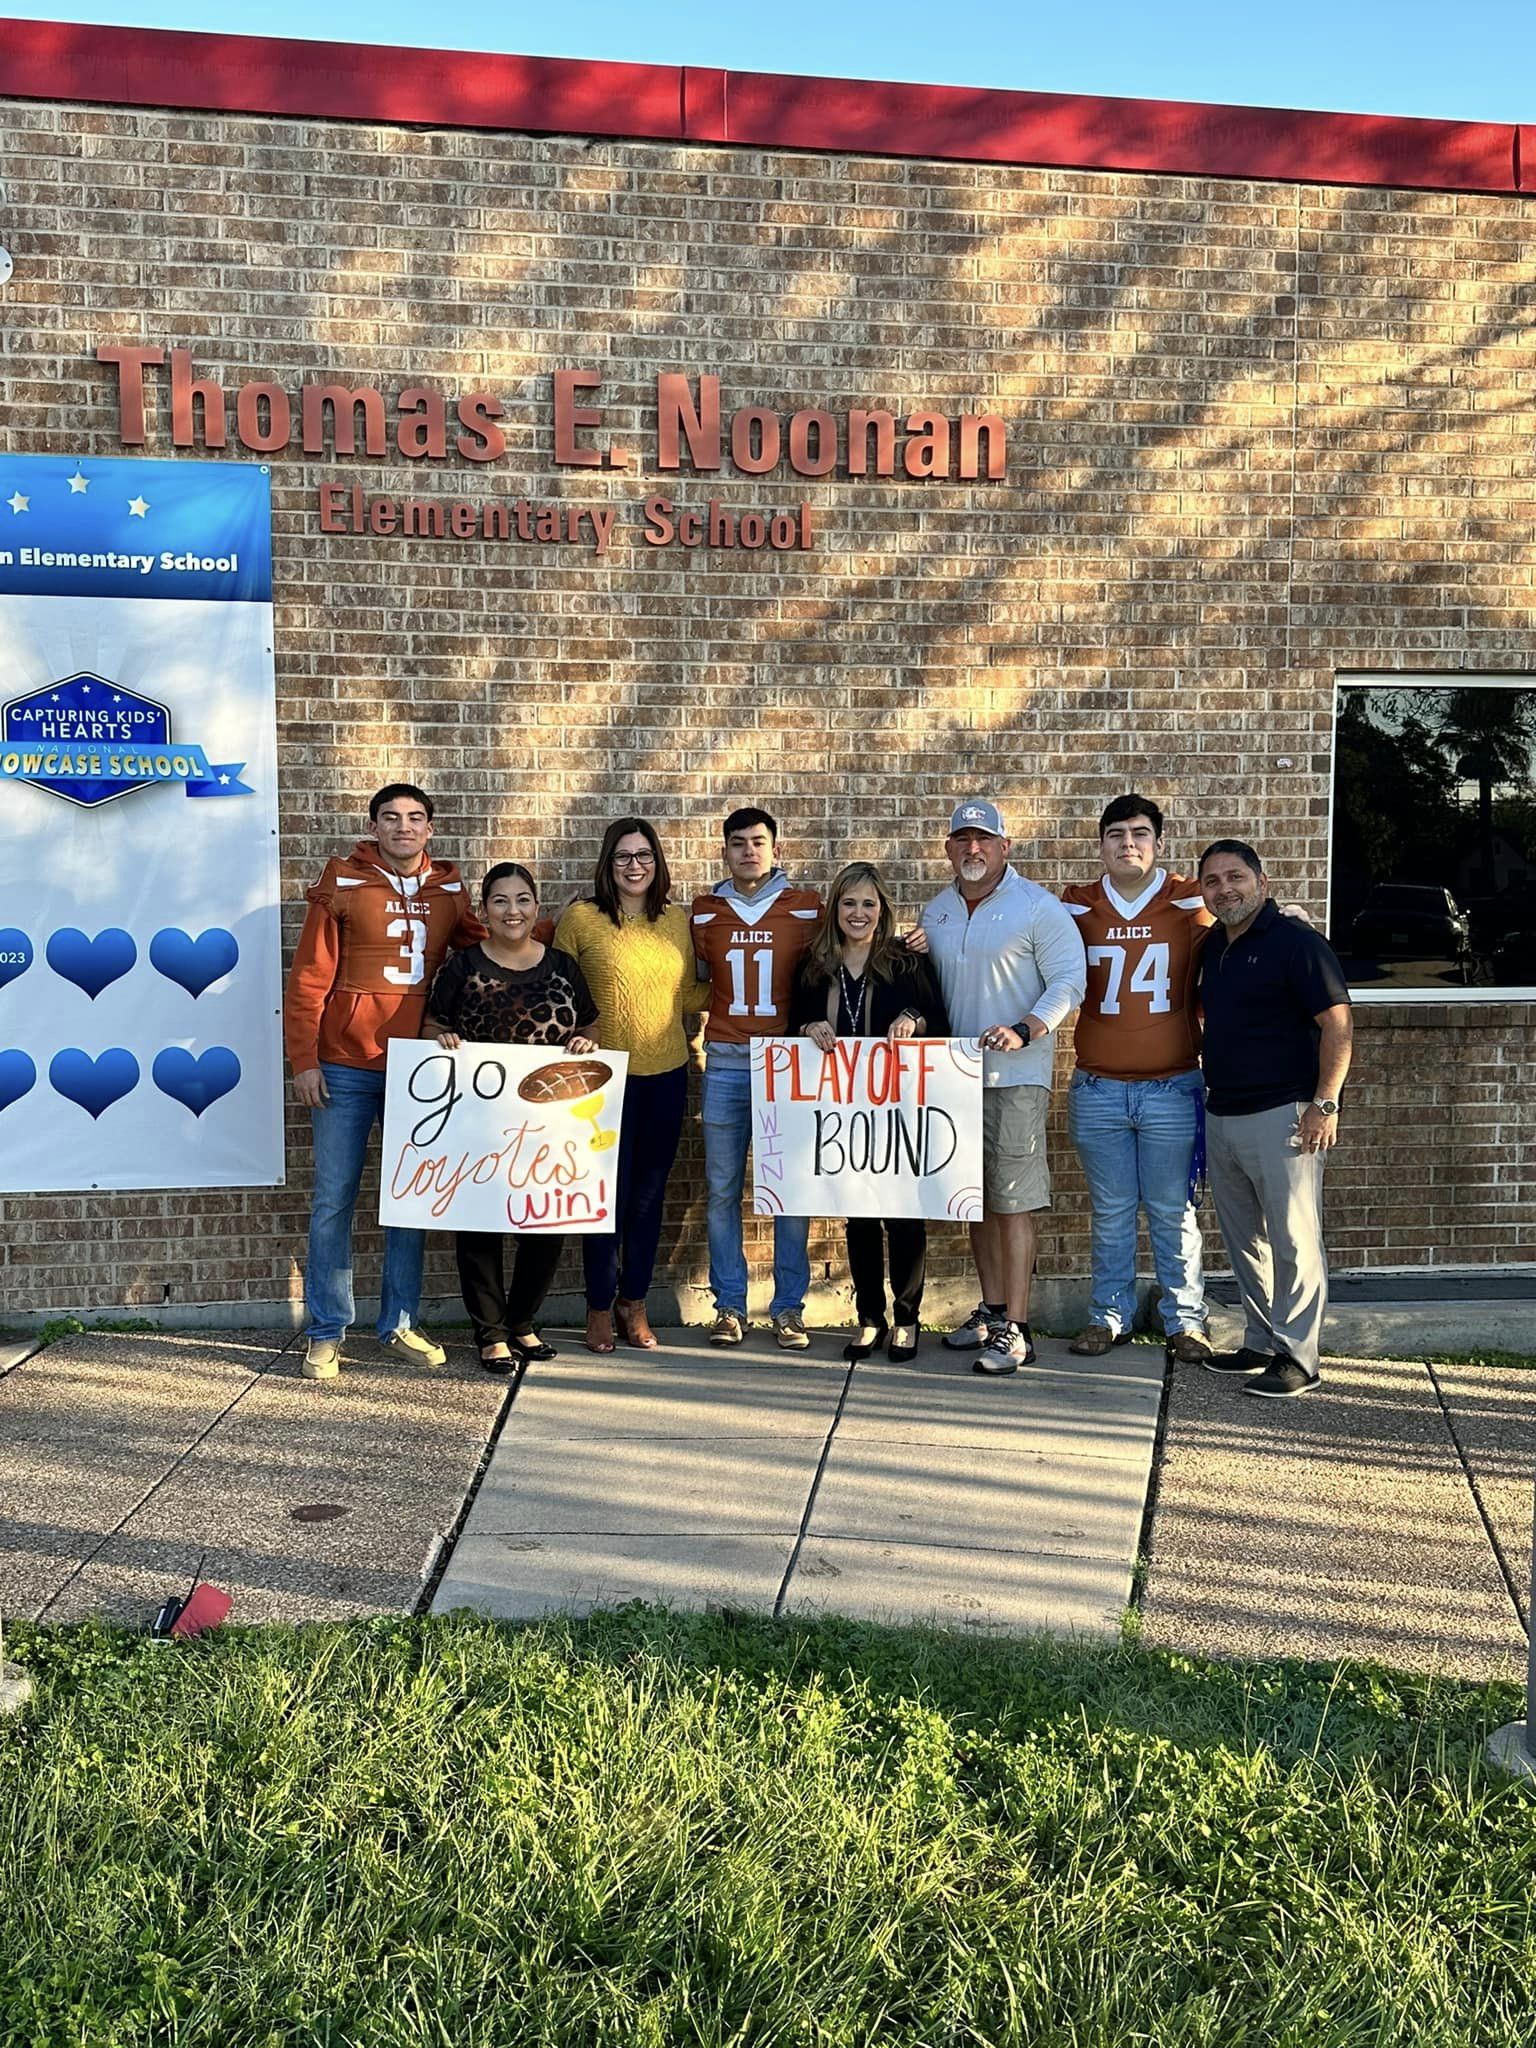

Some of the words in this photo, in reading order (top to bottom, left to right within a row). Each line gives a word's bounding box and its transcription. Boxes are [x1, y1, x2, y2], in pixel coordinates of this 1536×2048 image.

[97, 345, 506, 463] Thomas
[553, 369, 629, 466] E.
[656, 372, 1008, 481] Noonan
[319, 482, 616, 555] Elementary
[643, 496, 813, 550] School
[19, 548, 156, 574] Elementary
[159, 552, 239, 573] School
[11, 708, 110, 723] CAPTURING
[116, 711, 161, 724] KIDS'
[42, 723, 132, 739] HEARTS
[0, 752, 102, 776] OWCASE
[109, 755, 205, 777] SCHOOL
[36, 744, 138, 755] NATIONAL
[383, 918, 427, 985] 3
[730, 931, 773, 943] ALICE
[1105, 926, 1152, 940] ALICE
[725, 948, 777, 1016] 11
[1087, 942, 1171, 1015] 74
[408, 1055, 507, 1147] go
[765, 1040, 947, 1106] PLAYOFF
[814, 1106, 957, 1177] BOUND
